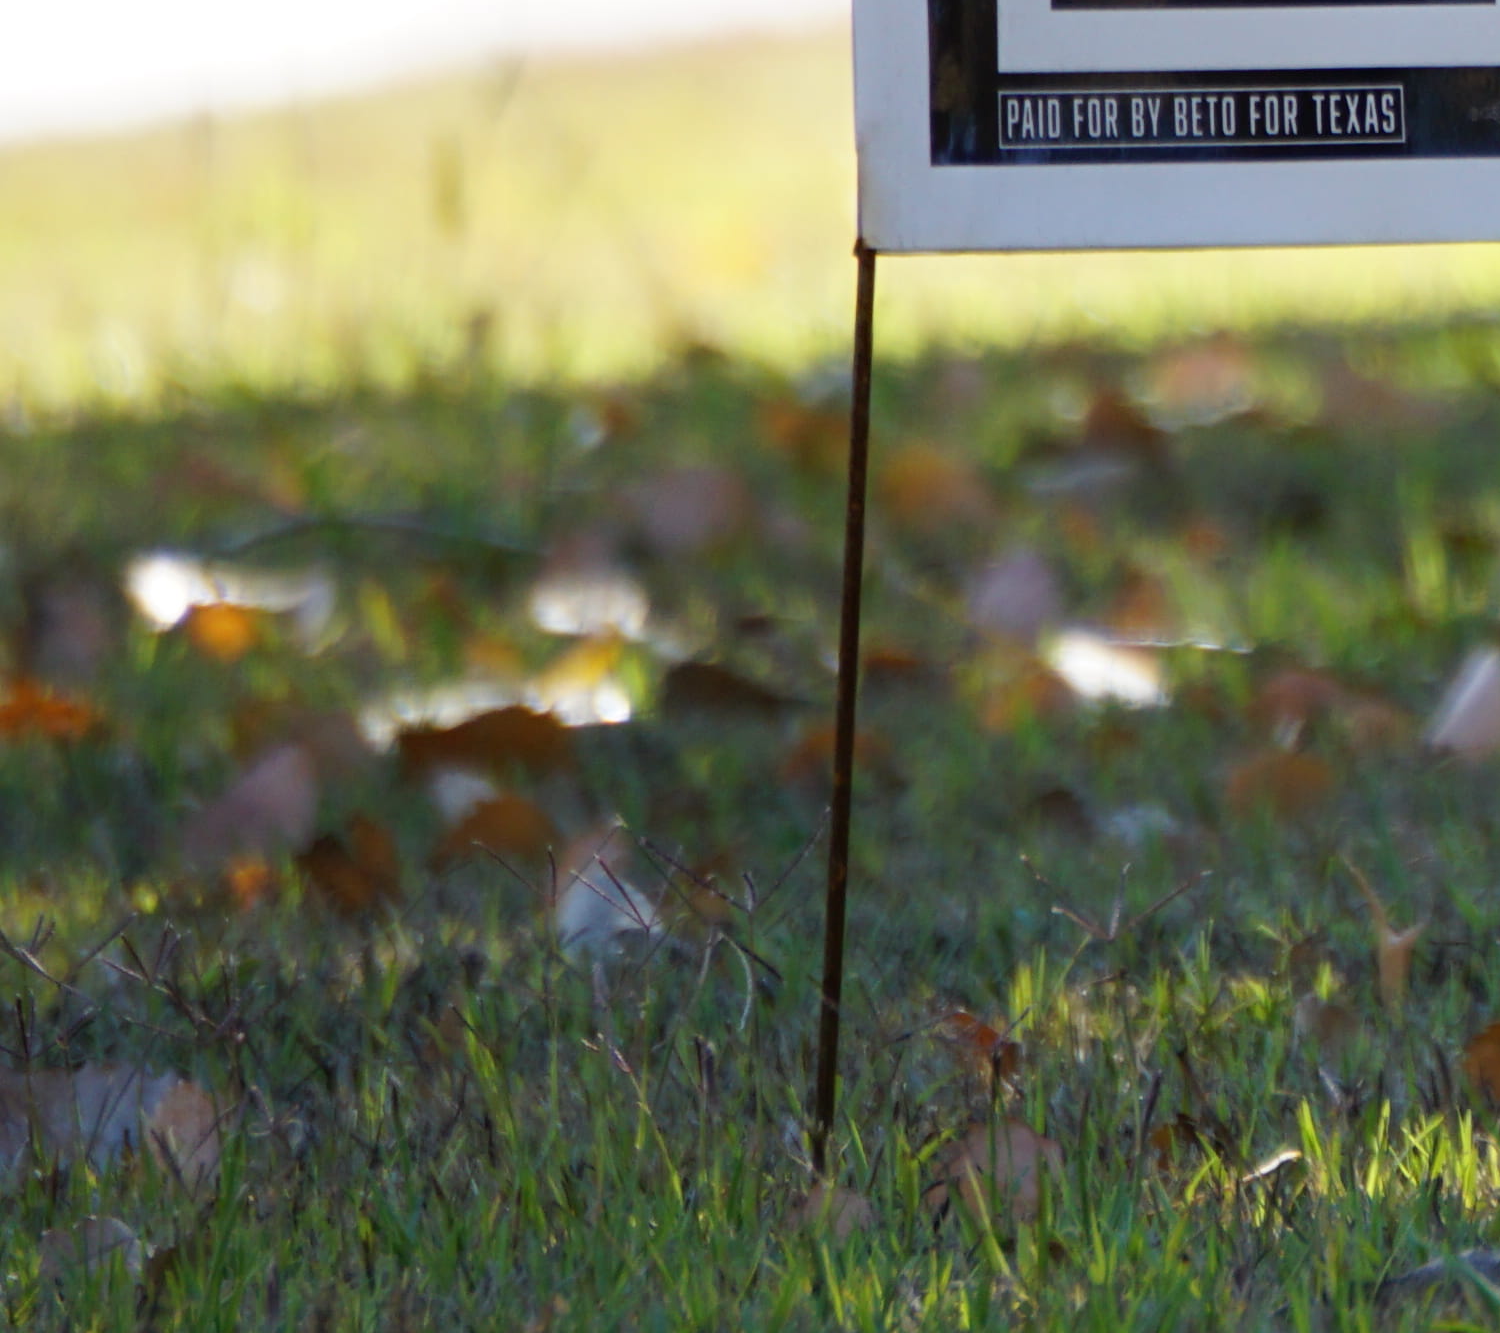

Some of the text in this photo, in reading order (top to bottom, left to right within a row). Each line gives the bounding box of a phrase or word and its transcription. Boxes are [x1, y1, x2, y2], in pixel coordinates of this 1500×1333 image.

[1006, 92, 1396, 139] PAID FOR BY BETO FOR TEXAS
